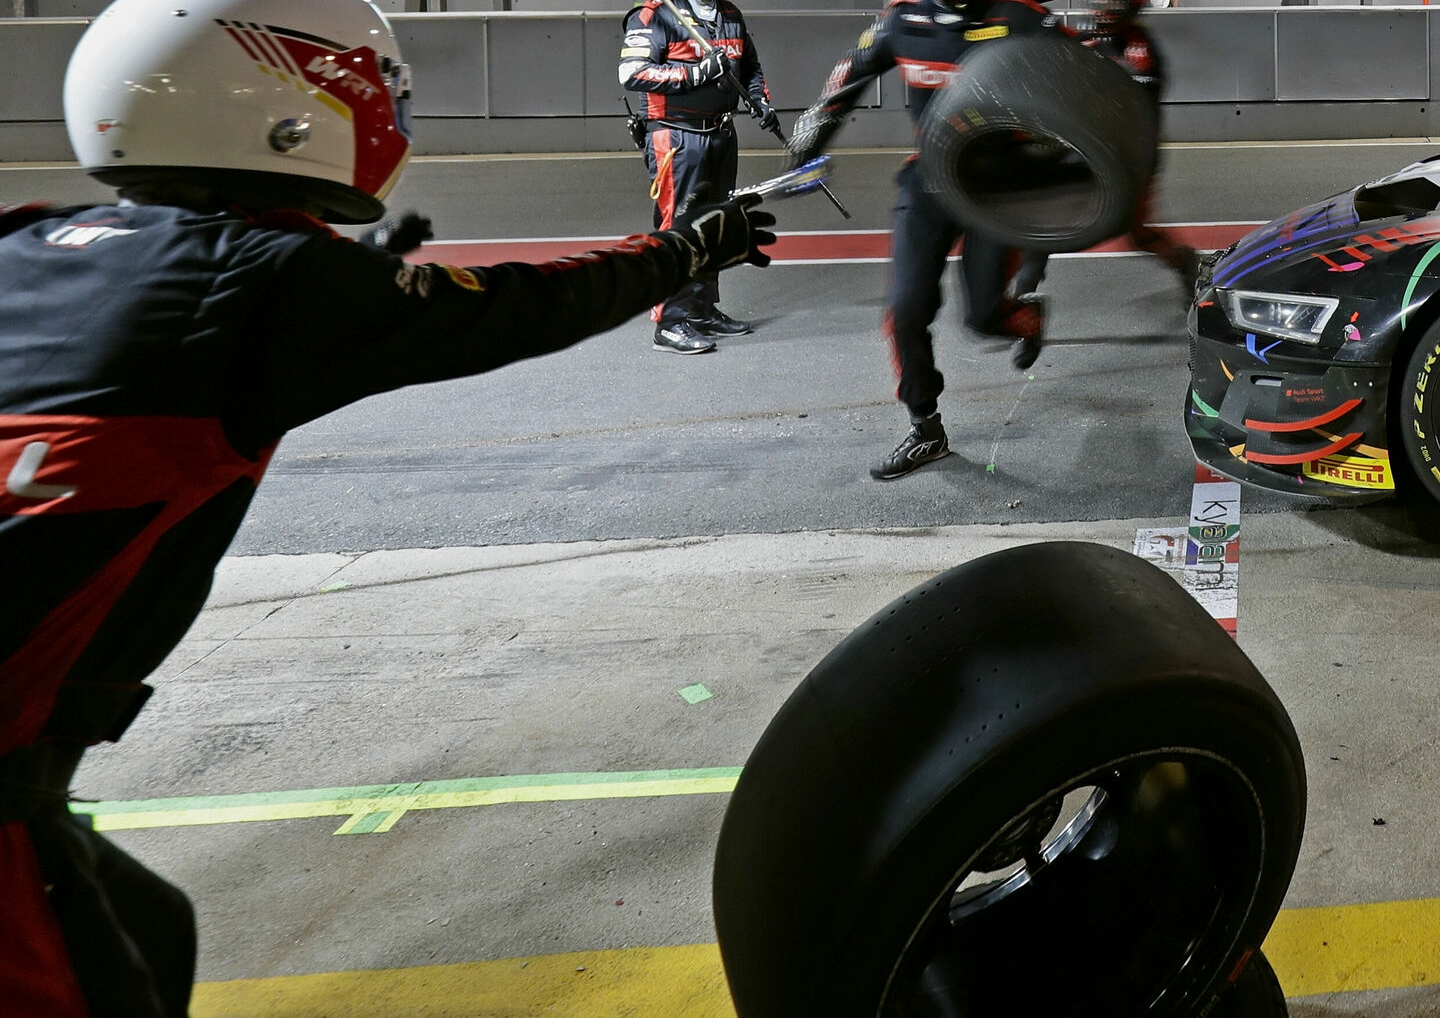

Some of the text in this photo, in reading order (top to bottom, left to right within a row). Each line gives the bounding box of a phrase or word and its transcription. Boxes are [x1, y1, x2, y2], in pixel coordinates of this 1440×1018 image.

[304, 55, 381, 101] WRT
[1306, 387, 1324, 396] Sport
[1310, 459, 1385, 484] PIRELLI
